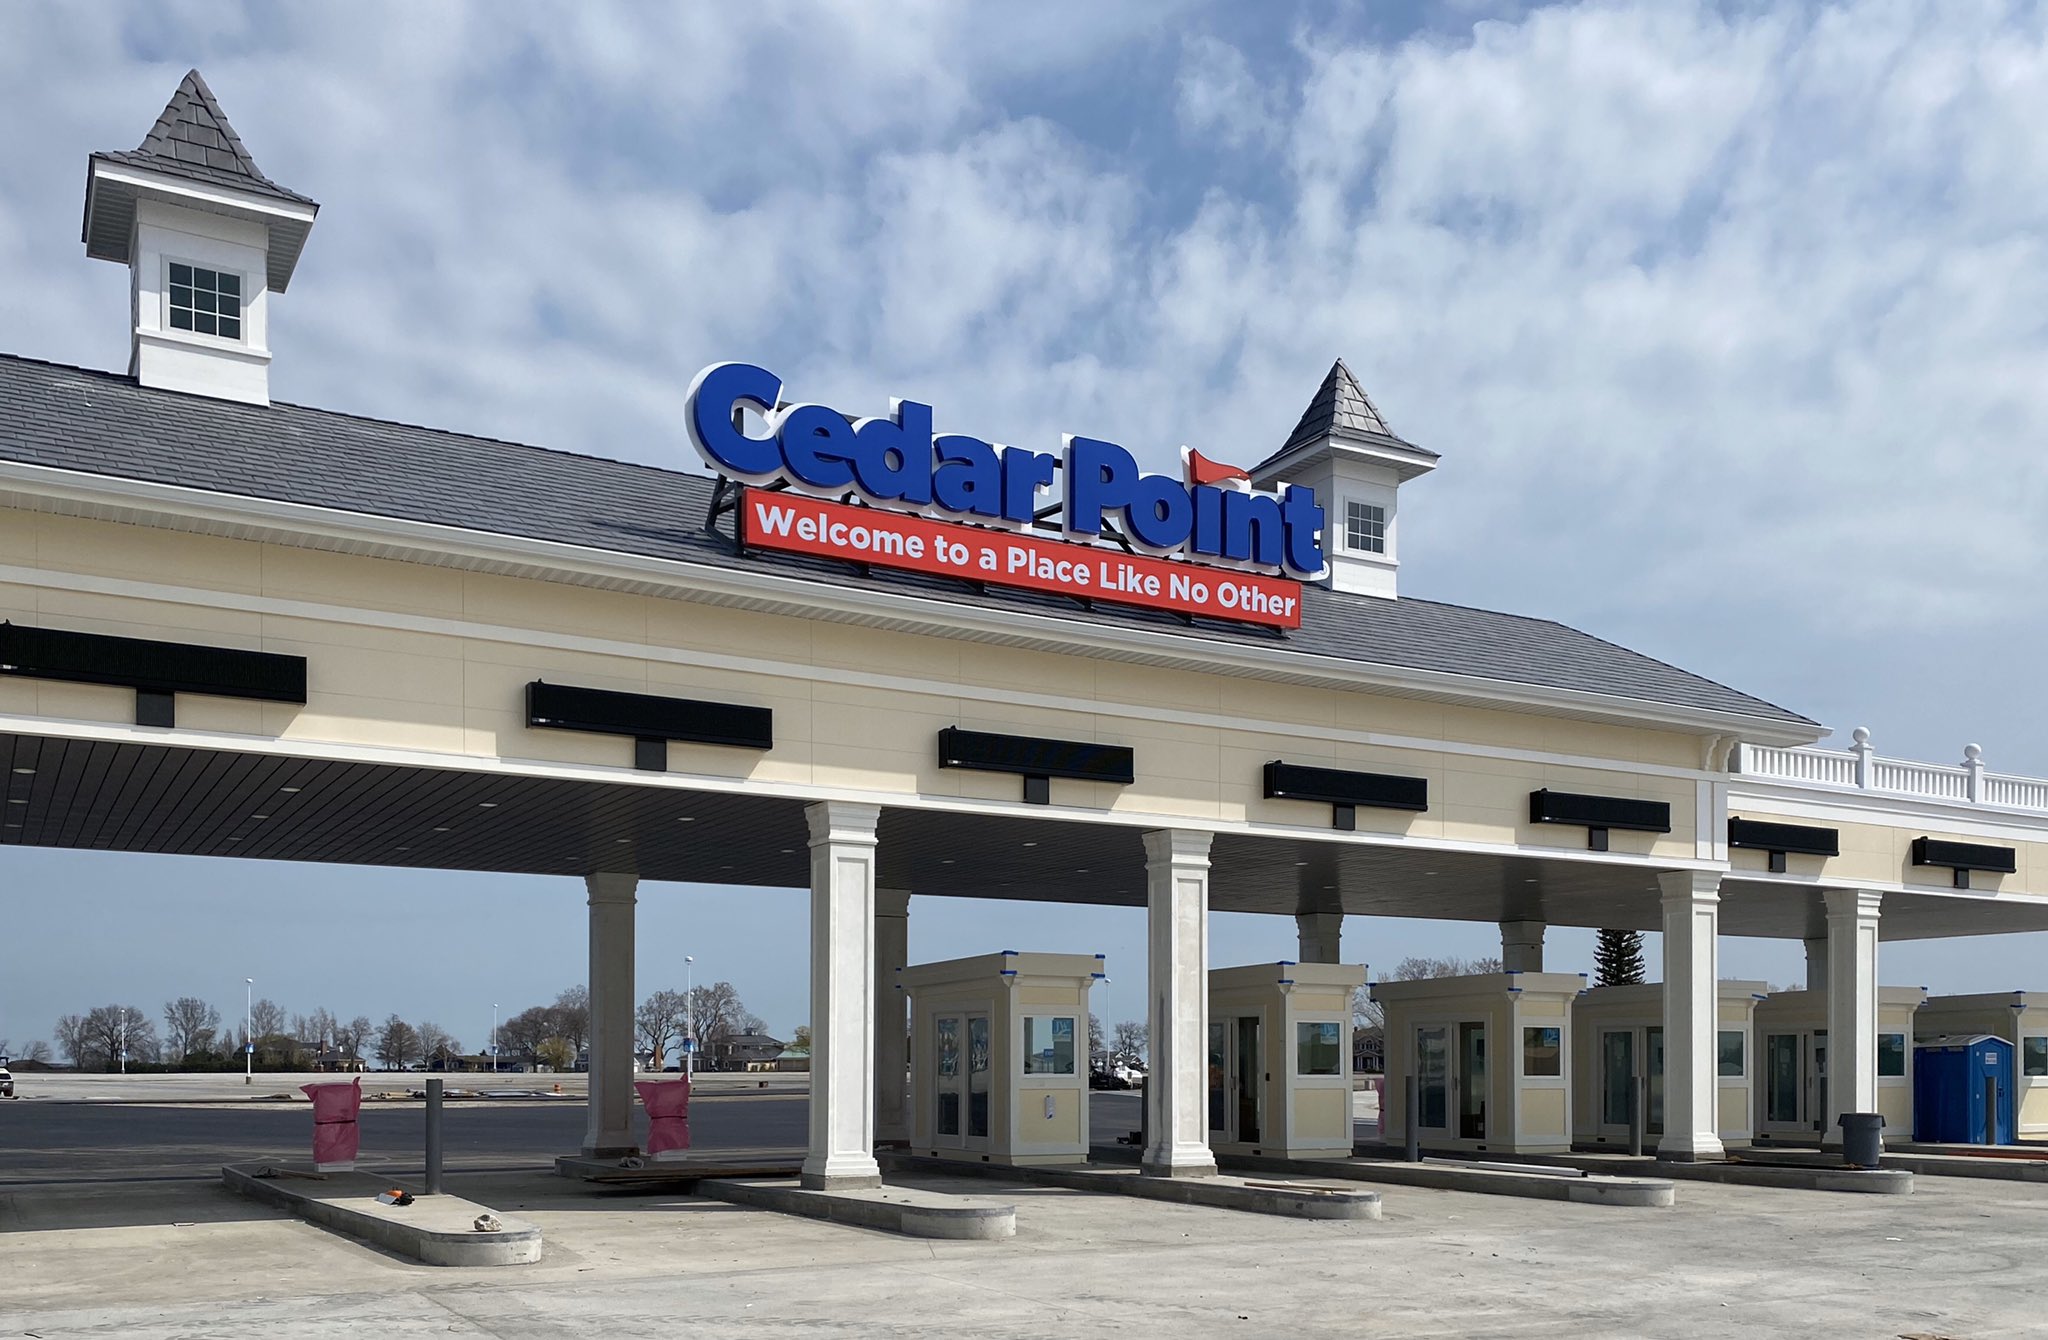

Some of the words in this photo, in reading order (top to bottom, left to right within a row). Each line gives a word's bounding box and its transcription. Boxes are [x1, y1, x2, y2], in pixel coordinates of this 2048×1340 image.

[690, 362, 1057, 525] Cedar
[1066, 434, 1326, 574] Point
[755, 503, 925, 560] Welcome
[933, 535, 971, 567] to
[977, 547, 998, 572] a
[1006, 545, 1092, 587] Place
[1098, 561, 1162, 598] Like
[1168, 573, 1210, 605] No
[1216, 581, 1297, 618] Other
